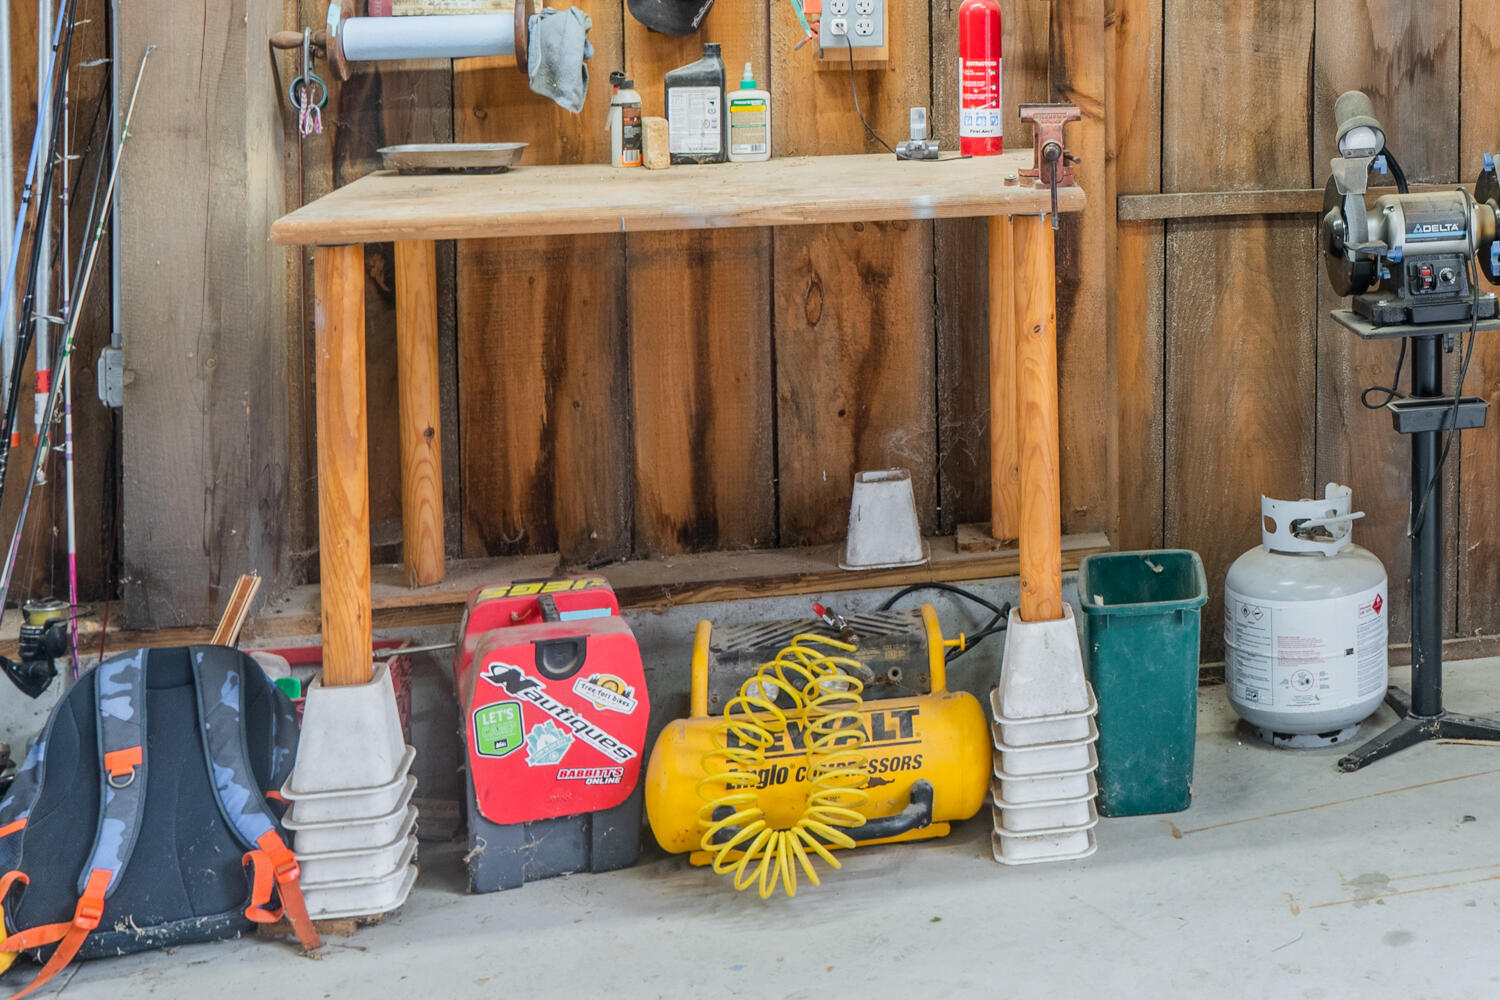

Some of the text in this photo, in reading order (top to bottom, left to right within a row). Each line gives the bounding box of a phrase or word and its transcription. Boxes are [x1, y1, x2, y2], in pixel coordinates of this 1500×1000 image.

[1423, 223, 1459, 233] DELTA
[482, 707, 514, 726] LET'S
[483, 664, 635, 760] Nautiques
[559, 767, 623, 779] BABBITT'S
[585, 776, 621, 785] ONLINE
